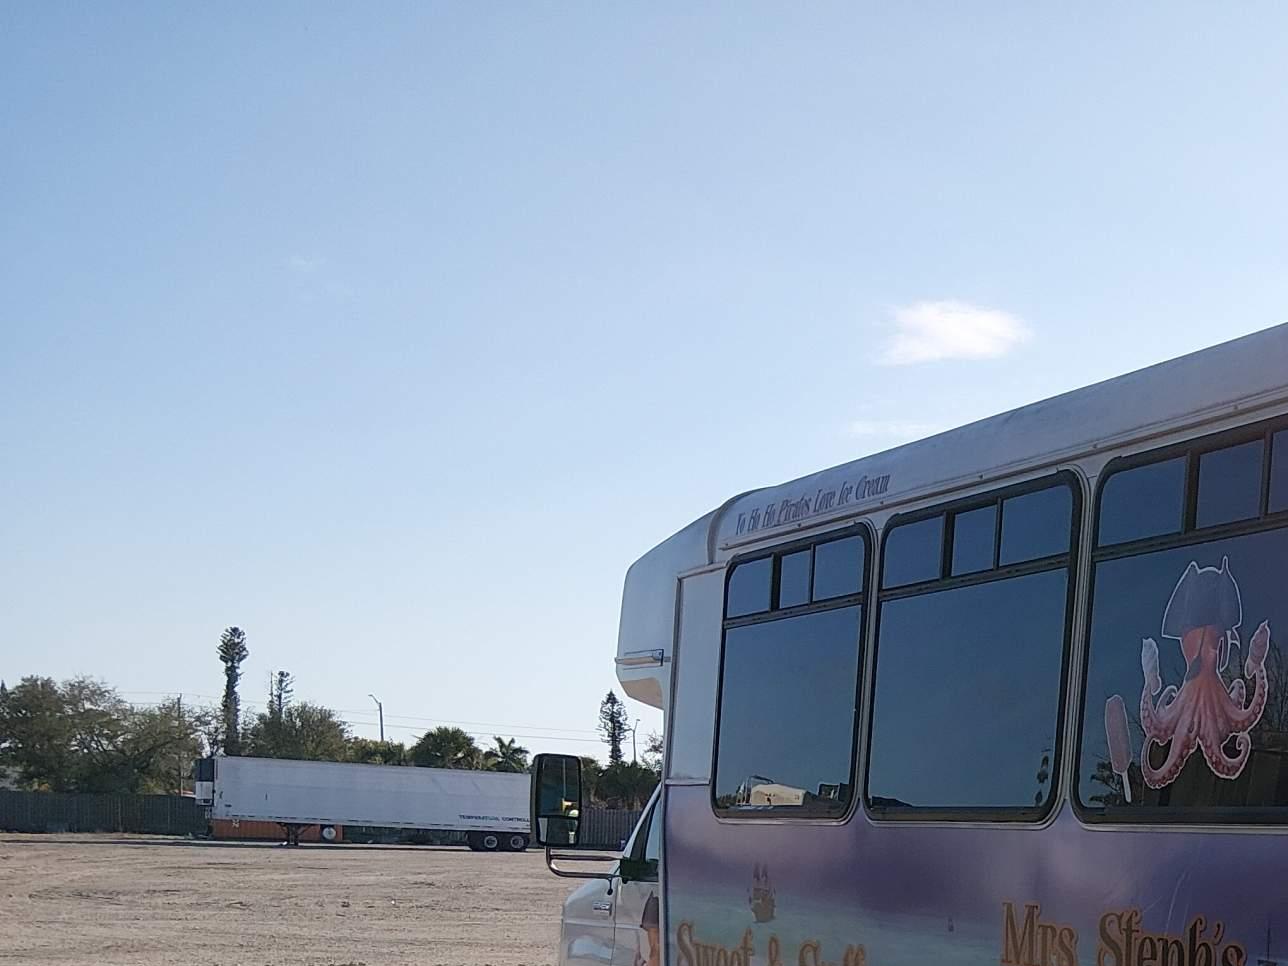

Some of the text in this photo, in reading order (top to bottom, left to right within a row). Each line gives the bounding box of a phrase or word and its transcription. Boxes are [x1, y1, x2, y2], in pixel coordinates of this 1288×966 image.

[747, 508, 761, 533] Ho
[777, 494, 812, 524] Pirates
[813, 488, 837, 513] Love
[838, 481, 854, 506] Ice
[855, 474, 891, 501] Cream
